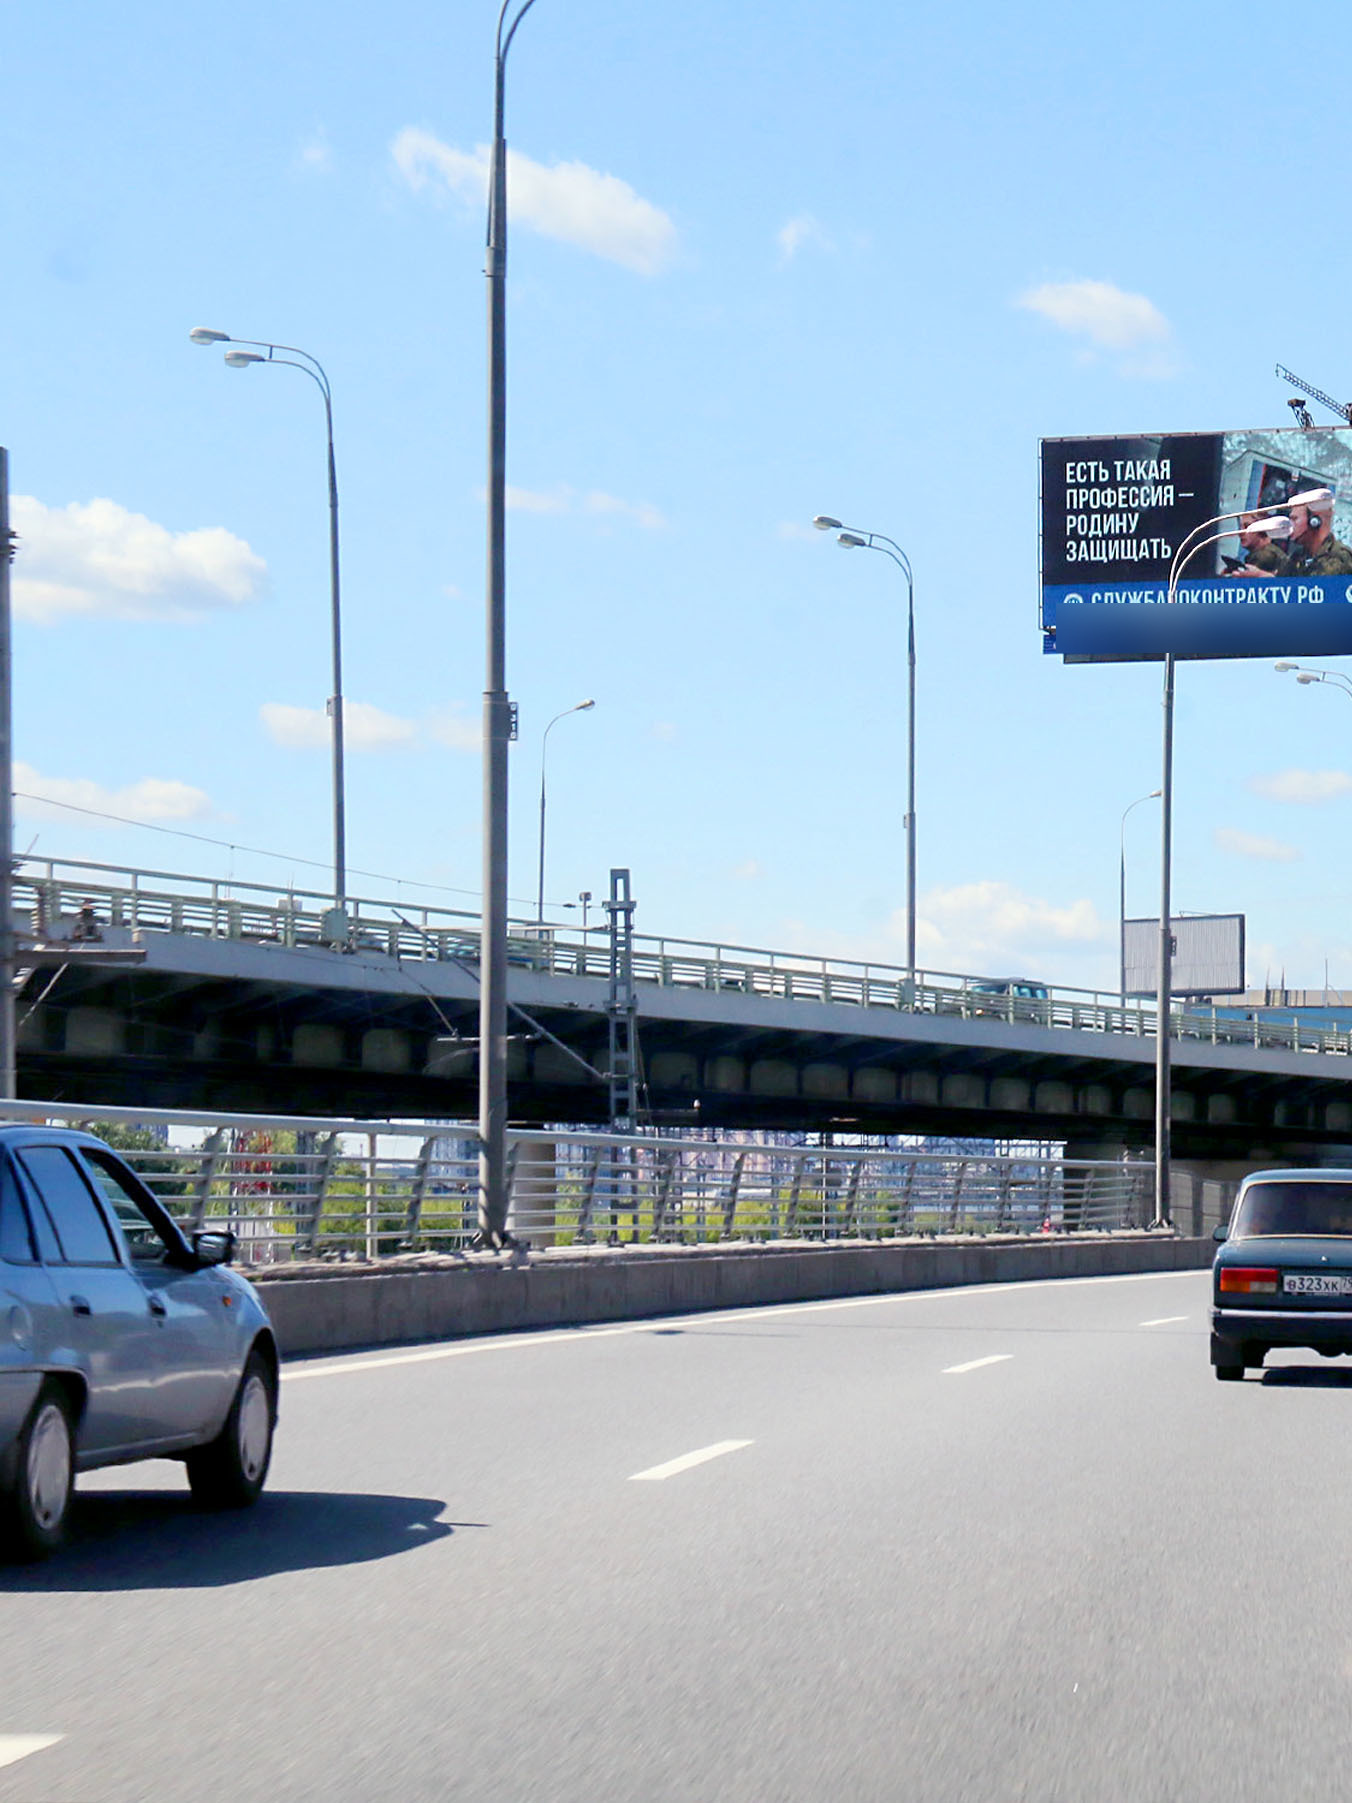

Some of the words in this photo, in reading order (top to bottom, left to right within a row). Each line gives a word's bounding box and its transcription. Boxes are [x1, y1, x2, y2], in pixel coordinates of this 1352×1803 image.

[1066, 461, 1109, 483] ЕСТЬ
[1114, 459, 1171, 481] ТАКАЯ
[1066, 485, 1174, 509] ПРОФЕССИЯ
[1066, 512, 1139, 538] РОДИНУ
[1066, 538, 1172, 563] ЗАЩИЩАТЬ
[1297, 585, 1324, 603] РФ
